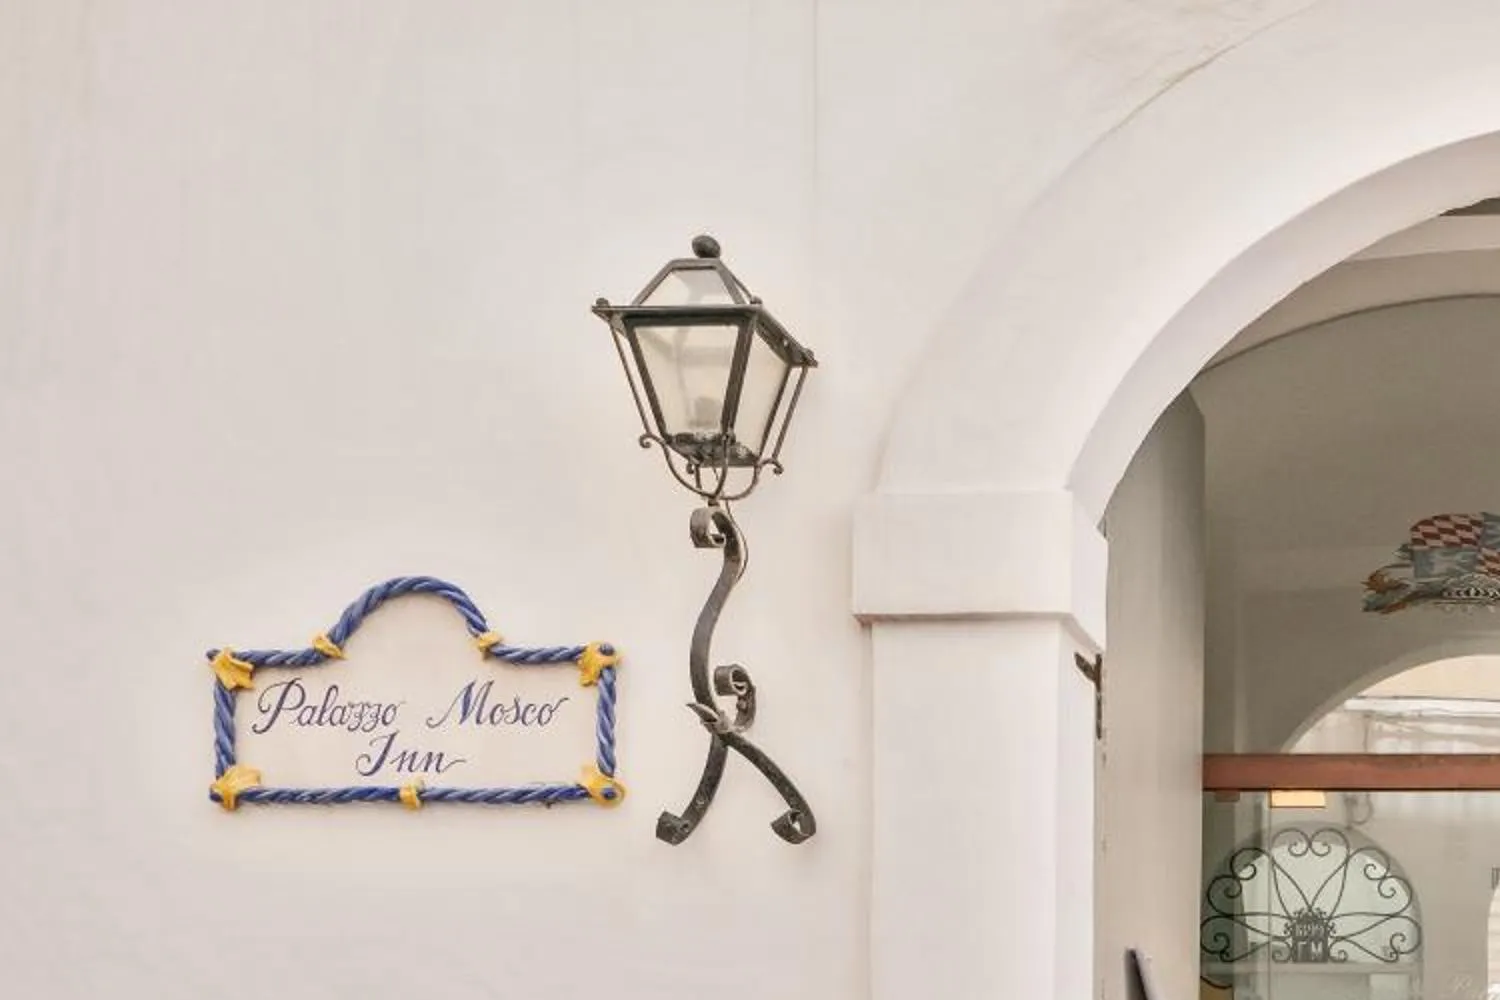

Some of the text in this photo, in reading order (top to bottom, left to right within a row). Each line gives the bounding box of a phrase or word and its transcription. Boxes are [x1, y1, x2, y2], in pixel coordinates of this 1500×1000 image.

[251, 676, 569, 735] Palazzo Mosco
[354, 730, 466, 777] Inn
